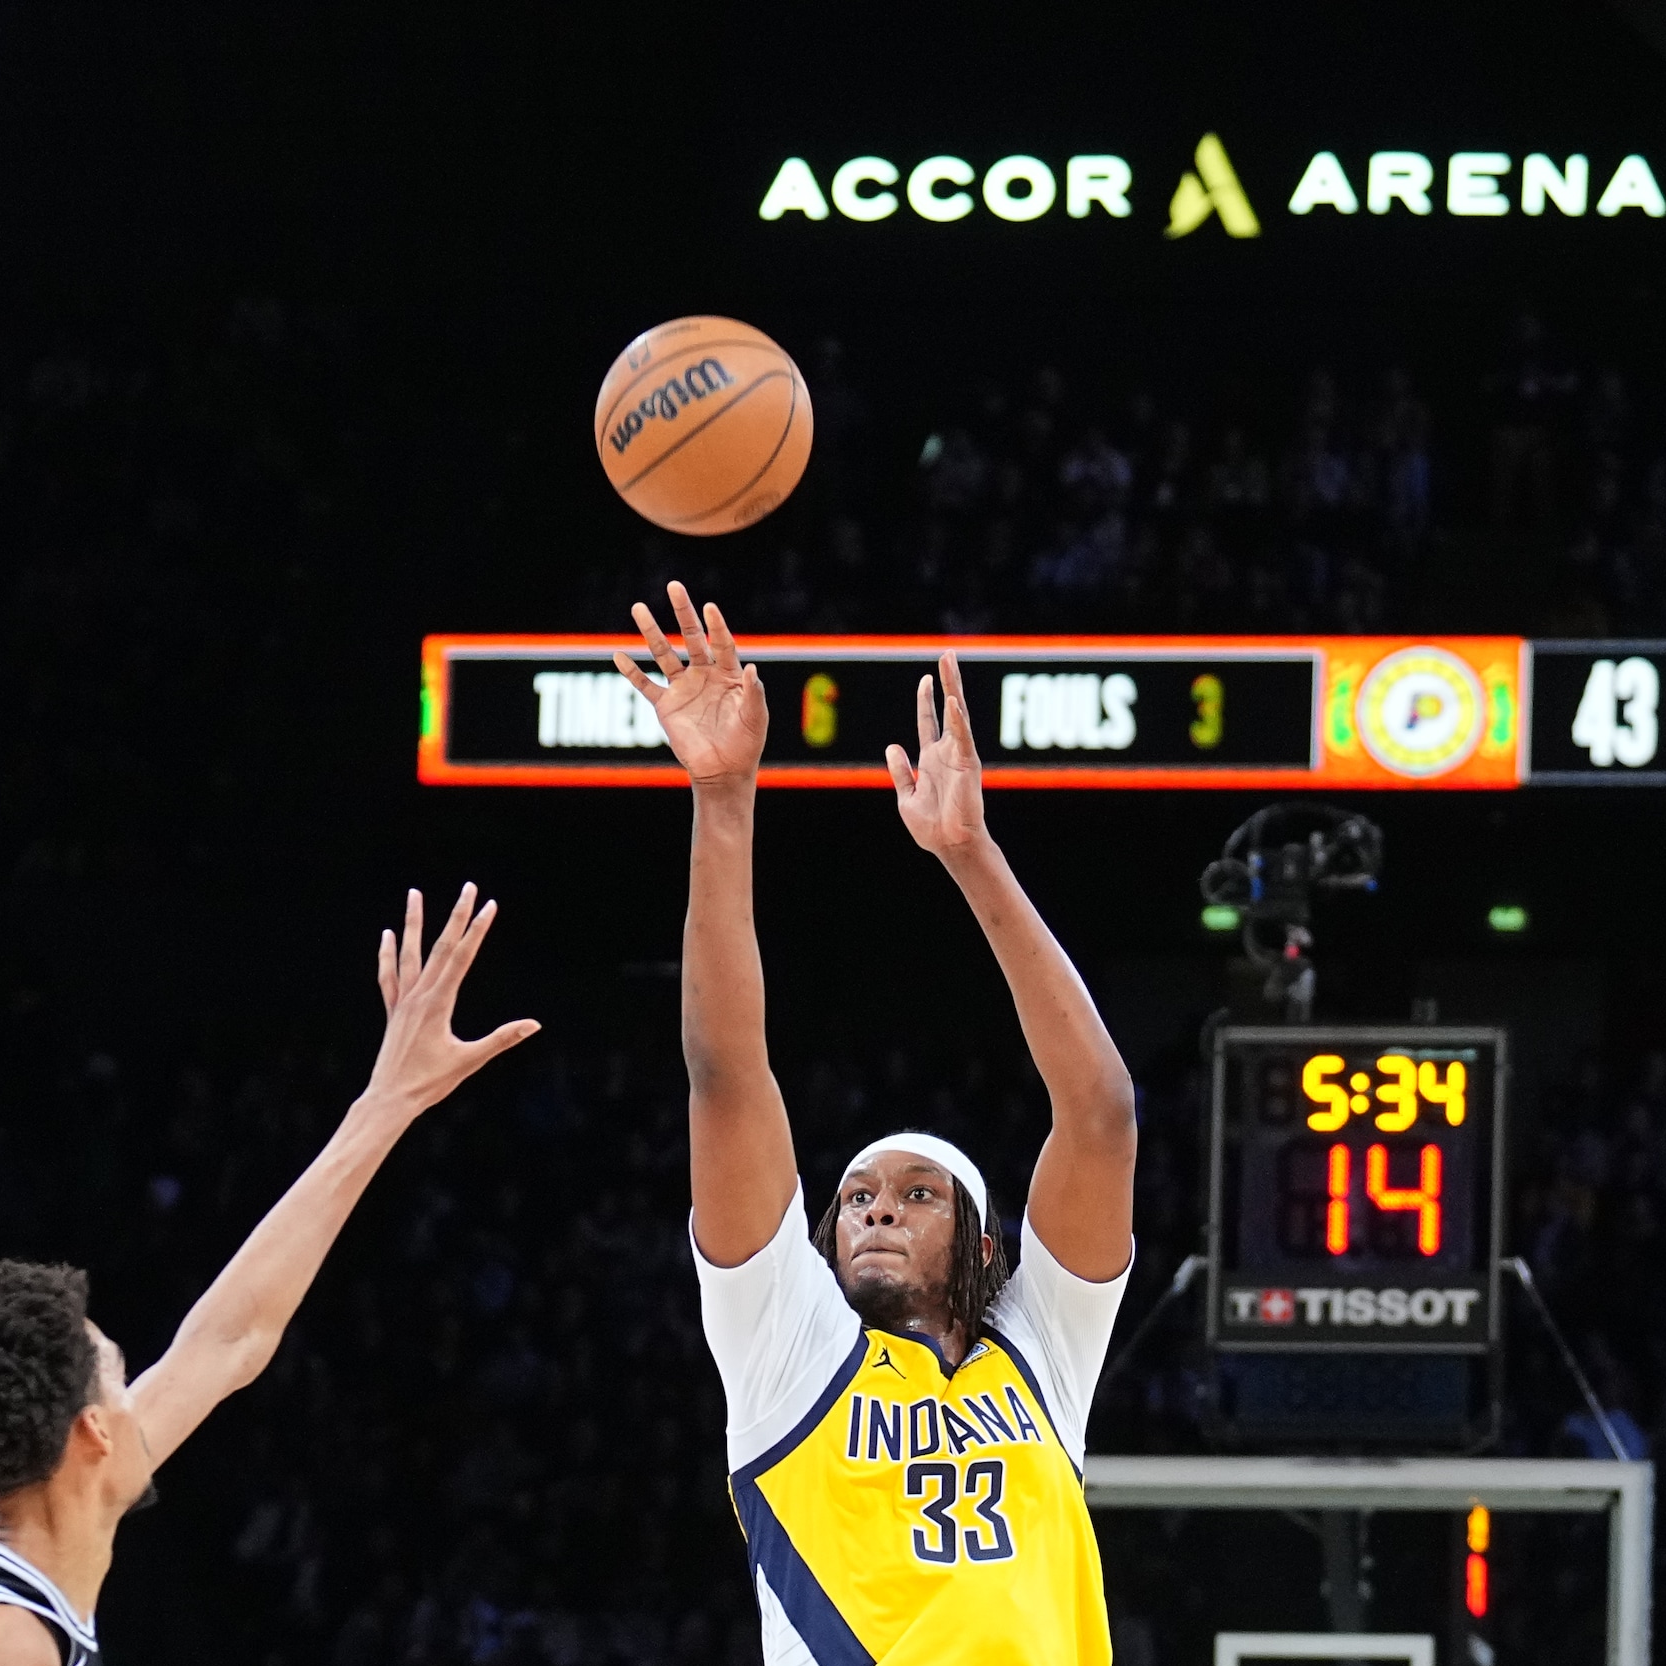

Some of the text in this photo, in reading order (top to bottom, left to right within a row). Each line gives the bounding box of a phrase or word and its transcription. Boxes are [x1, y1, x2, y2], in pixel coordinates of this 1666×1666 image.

[758, 151, 1666, 222] ACCOR ARENA
[999, 673, 1223, 751] FOULS 3
[1571, 656, 1660, 767] 43
[1301, 1053, 1467, 1133] 5:34
[1325, 1142, 1444, 1257] 14
[1295, 1287, 1481, 1326] TISSOT
[846, 1382, 1044, 1463] INDANA
[905, 1458, 1017, 1566] 33
